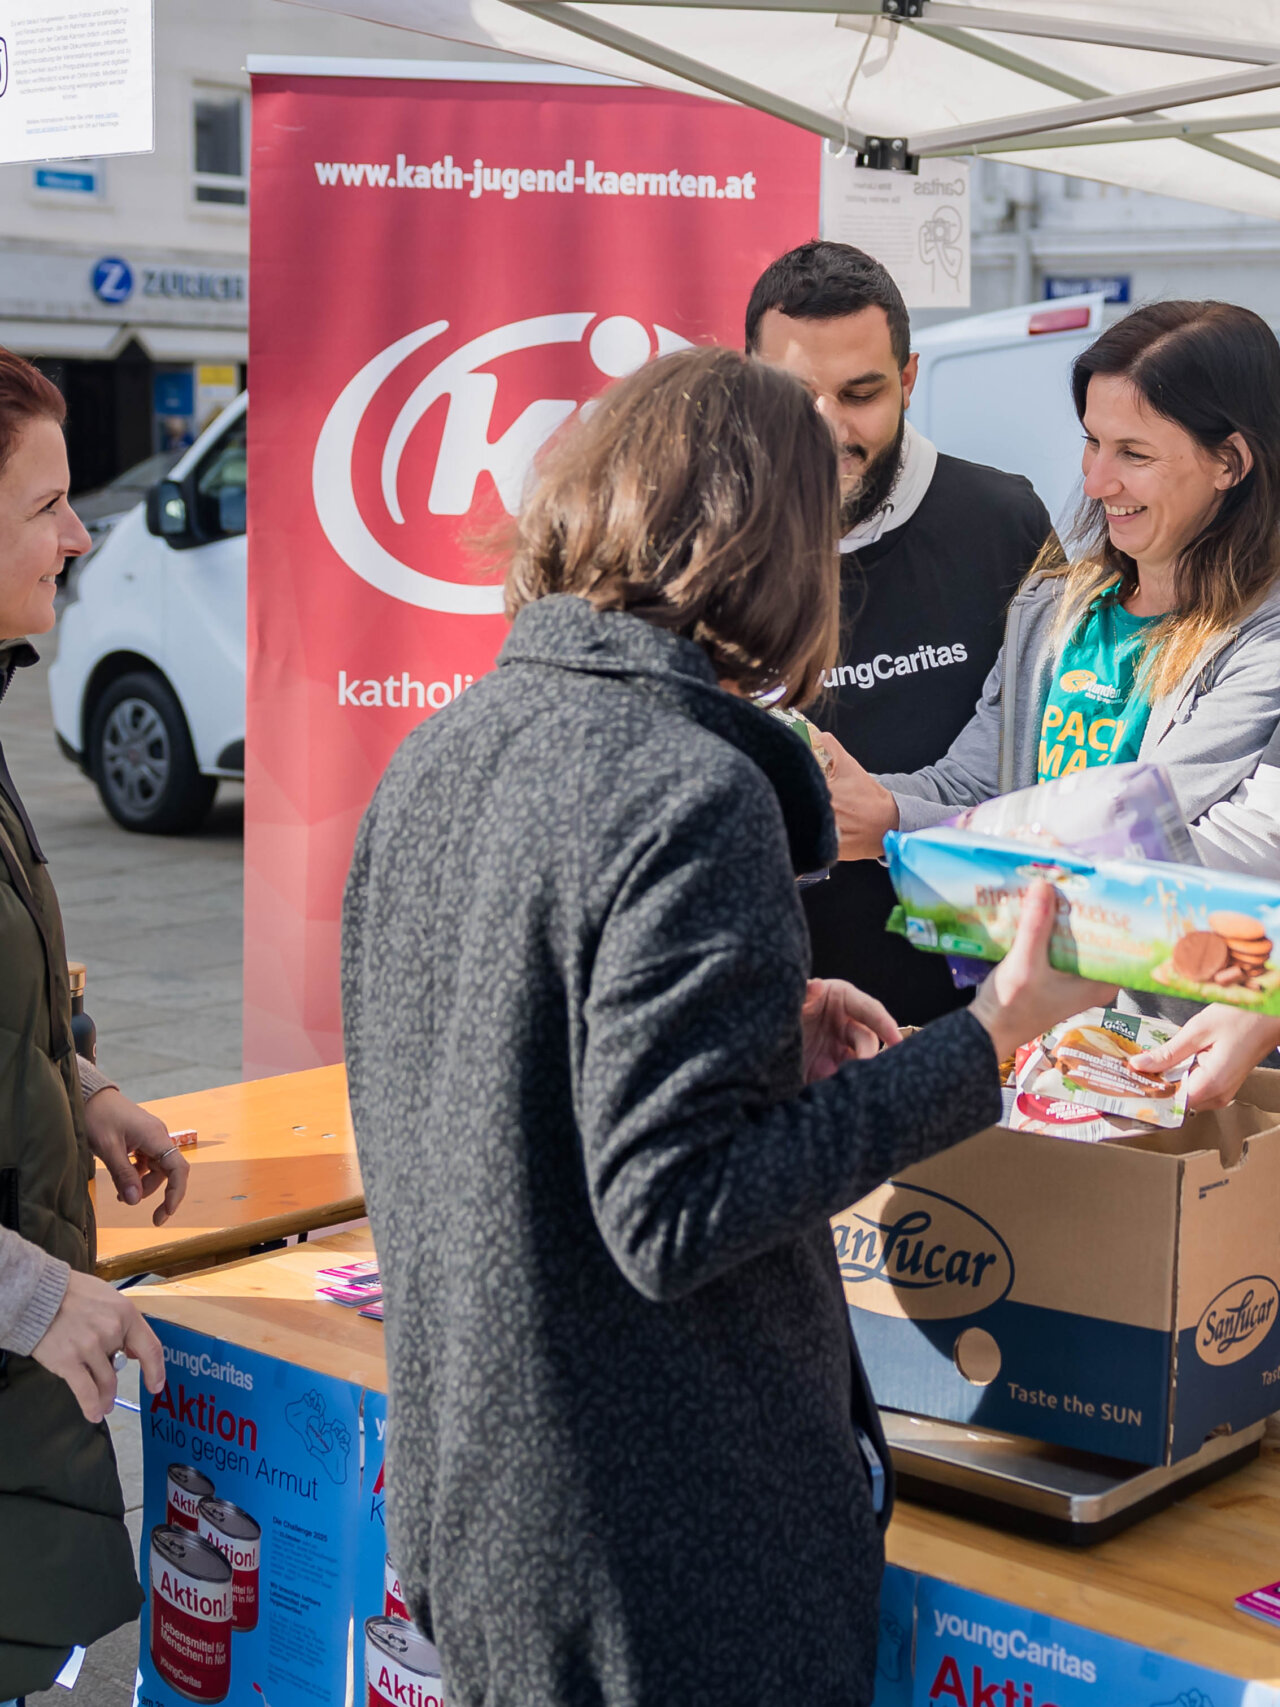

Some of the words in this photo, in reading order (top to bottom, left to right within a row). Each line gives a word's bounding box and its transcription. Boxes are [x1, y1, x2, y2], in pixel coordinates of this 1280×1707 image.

[314, 154, 757, 200] www.kath-jugend-kaernten.at
[1202, 1289, 1275, 1354] SanLucar
[163, 1345, 254, 1392] oungCaritas
[150, 1379, 258, 1452] Aktion
[1007, 1383, 1058, 1410] Taste
[1063, 1394, 1095, 1418] the
[1101, 1403, 1143, 1427] SUN
[151, 1416, 186, 1448] Kilo
[192, 1436, 249, 1475] gegen
[255, 1457, 318, 1501] Armut
[160, 1571, 227, 1617] Aktion!
[160, 1615, 215, 1653] Lebensmittel
[216, 1642, 225, 1653] für
[160, 1627, 203, 1663] Menschen
[205, 1652, 213, 1665] in
[214, 1654, 226, 1666] Not
[933, 1609, 1097, 1684] youngCaritas
[160, 1655, 202, 1689] youngCaritas
[378, 1665, 445, 1707] Aktio
[929, 1655, 1063, 1707] Akti
